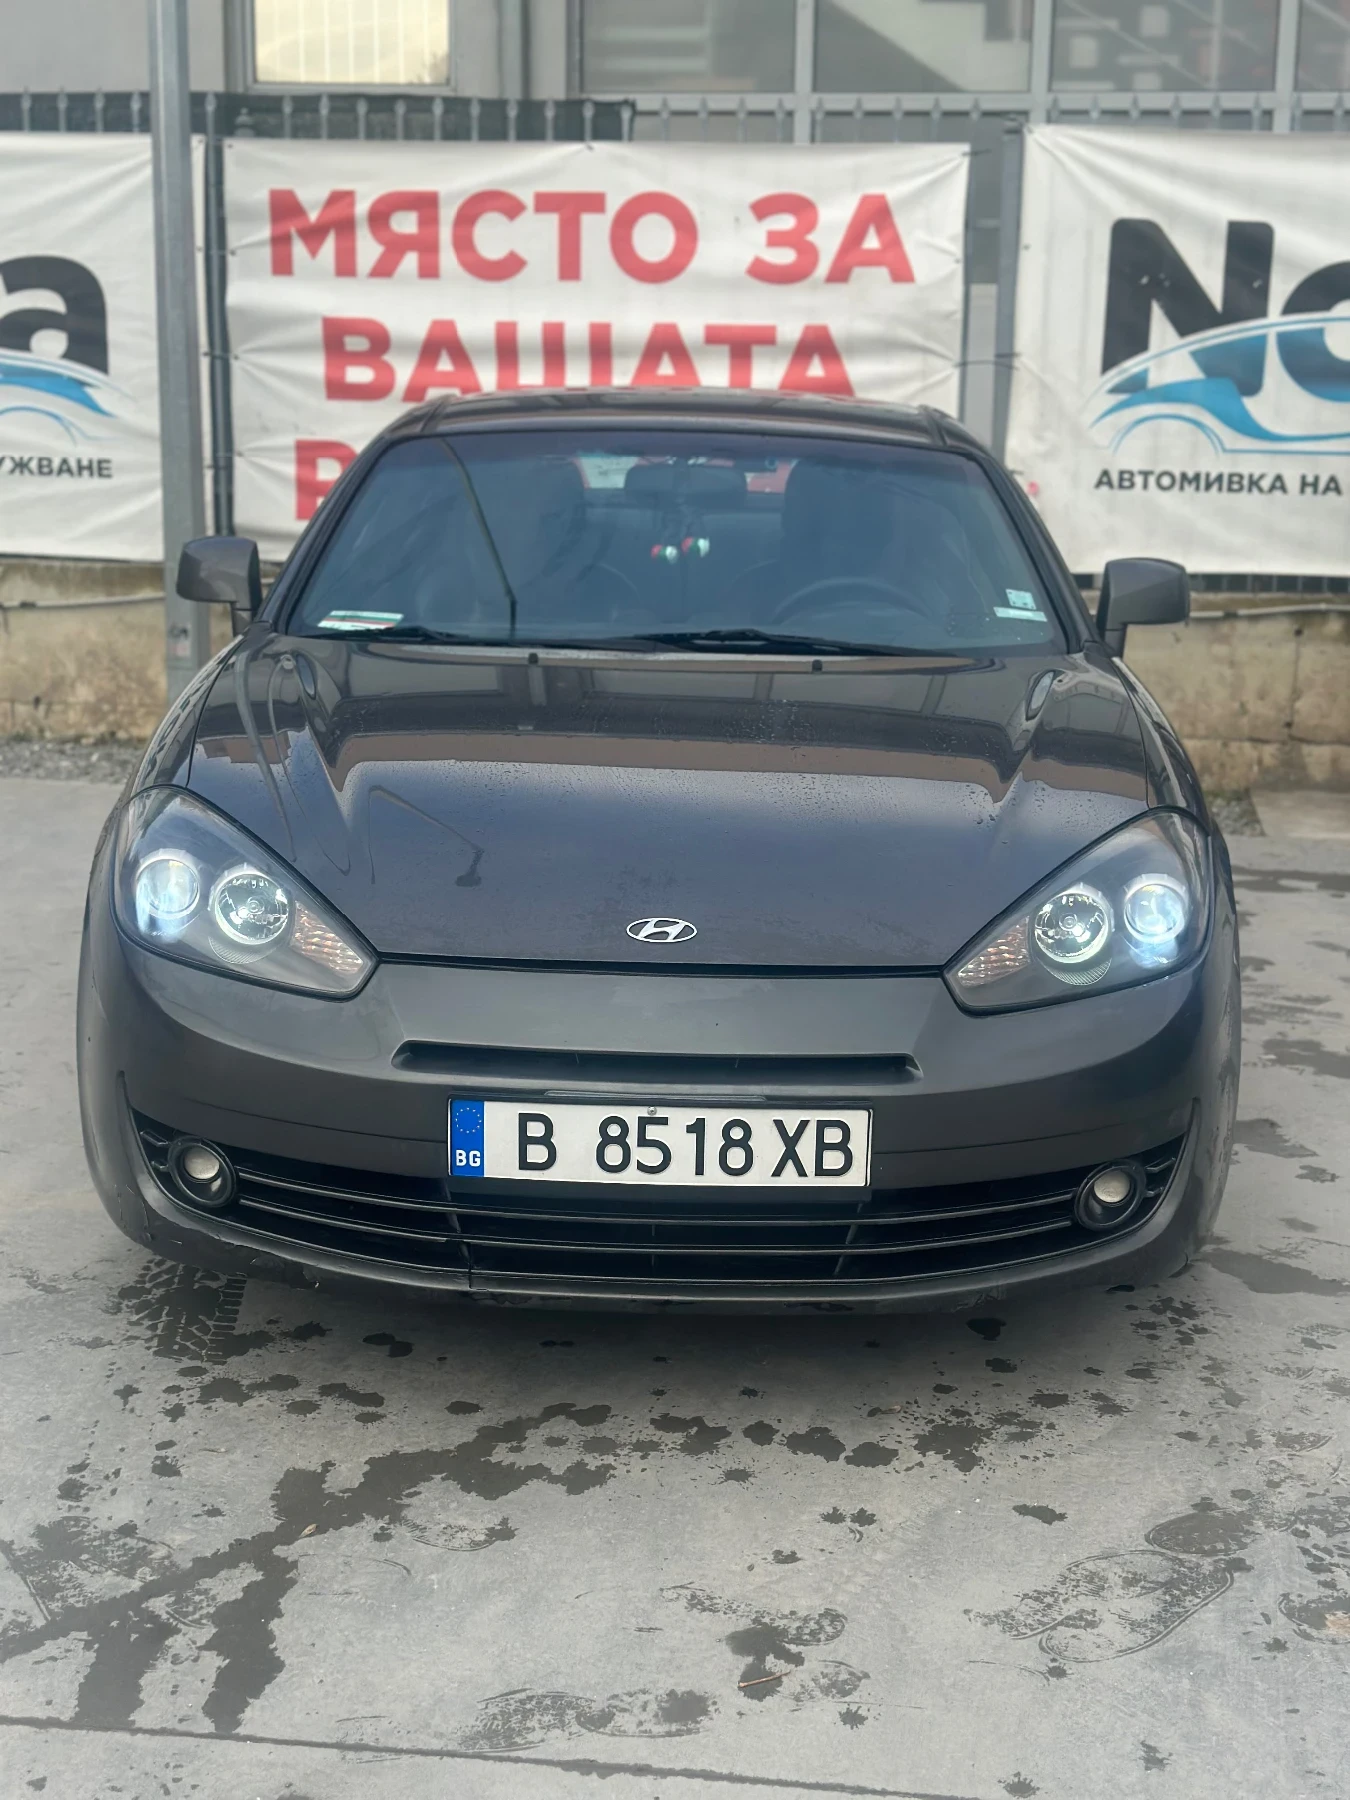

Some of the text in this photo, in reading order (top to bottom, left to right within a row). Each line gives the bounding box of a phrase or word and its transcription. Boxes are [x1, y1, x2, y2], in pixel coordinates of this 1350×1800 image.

[267, 187, 916, 285] МЯСТО ЗА
[321, 316, 856, 403] ВАШАТА
[0, 455, 113, 479] ЖВАНЕ
[1094, 468, 1344, 496] АВТОМИВКА НА
[455, 1149, 482, 1168] BG
[517, 1112, 854, 1178] B 8518 XB
